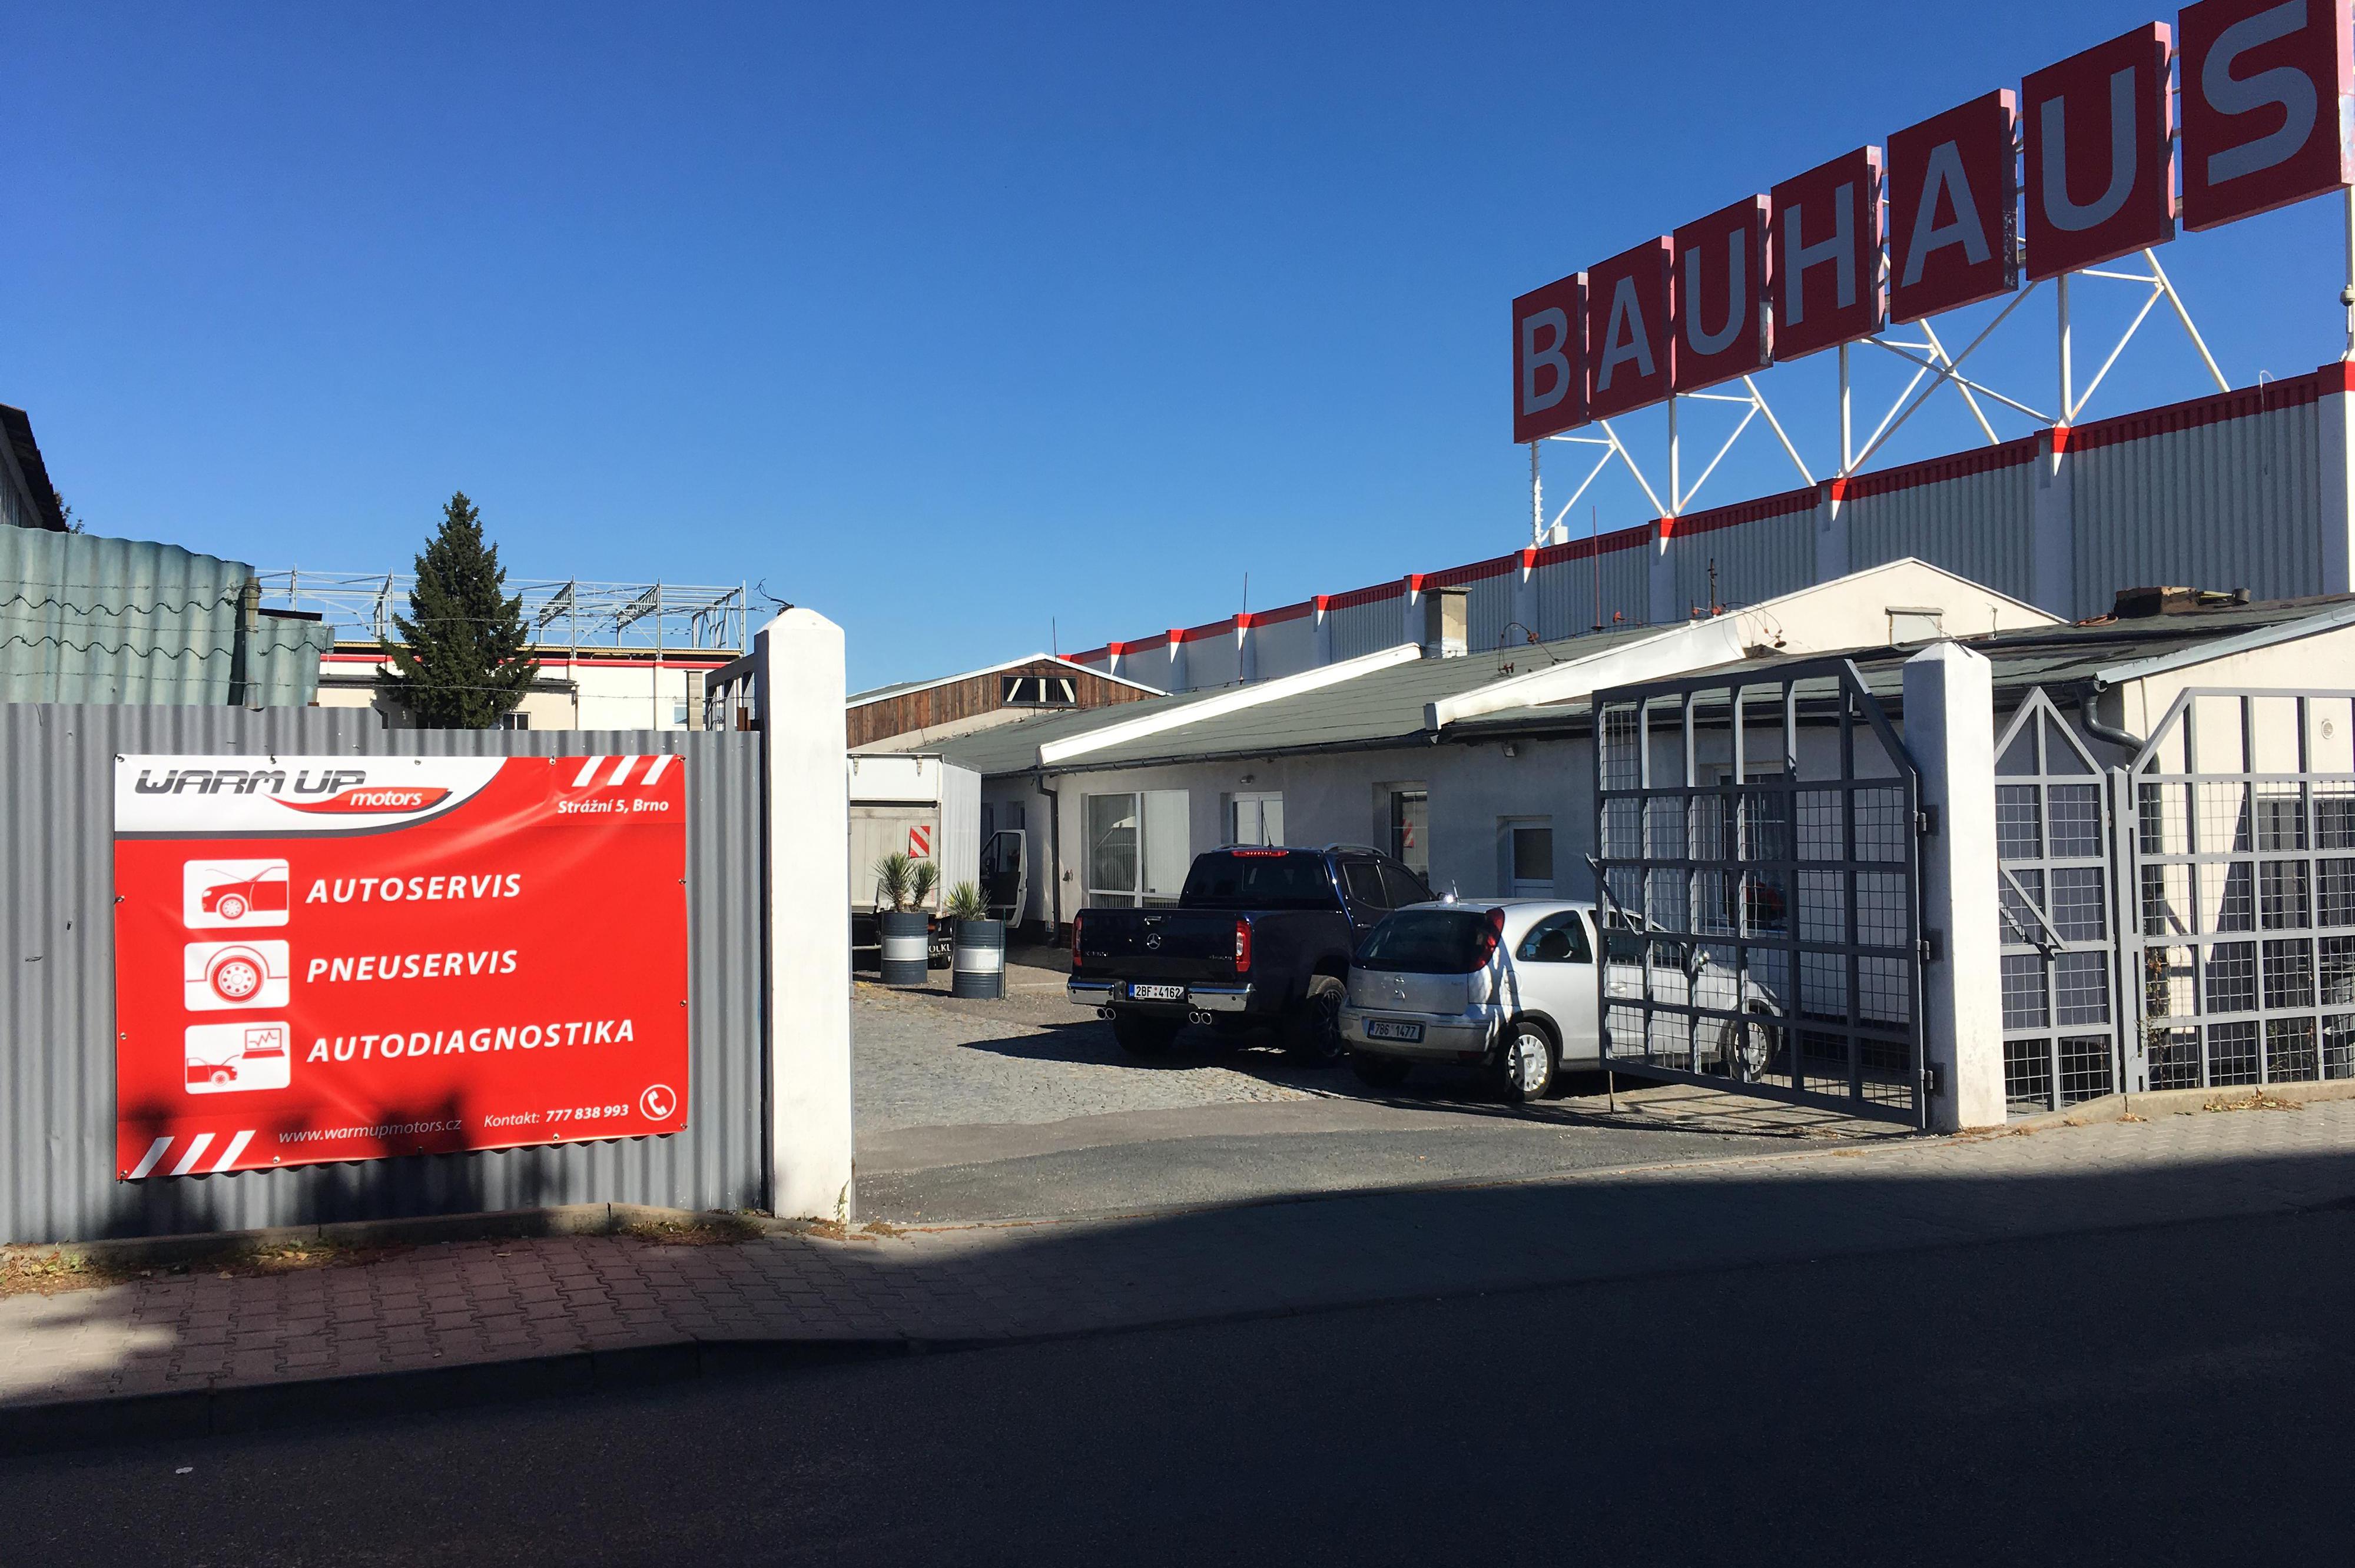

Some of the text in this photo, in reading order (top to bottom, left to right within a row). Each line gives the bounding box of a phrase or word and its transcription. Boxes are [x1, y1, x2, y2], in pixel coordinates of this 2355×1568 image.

[1523, 0, 2318, 417] BAUHAUS
[134, 769, 367, 794] WARM UP
[350, 790, 423, 807] motors
[558, 799, 669, 813] Strážní 5, Brno
[305, 873, 521, 903] AUTOSERVIS
[306, 949, 518, 983] PNEUSERVIS
[1136, 985, 1180, 998] 2BF 4162
[306, 1019, 634, 1063] AUTODIAGNOSTIKA
[1395, 1025, 1416, 1038] 1477
[483, 1104, 629, 1128] Kontakt: 777 838 993
[278, 1119, 462, 1143] www.warmupmotors.cz
